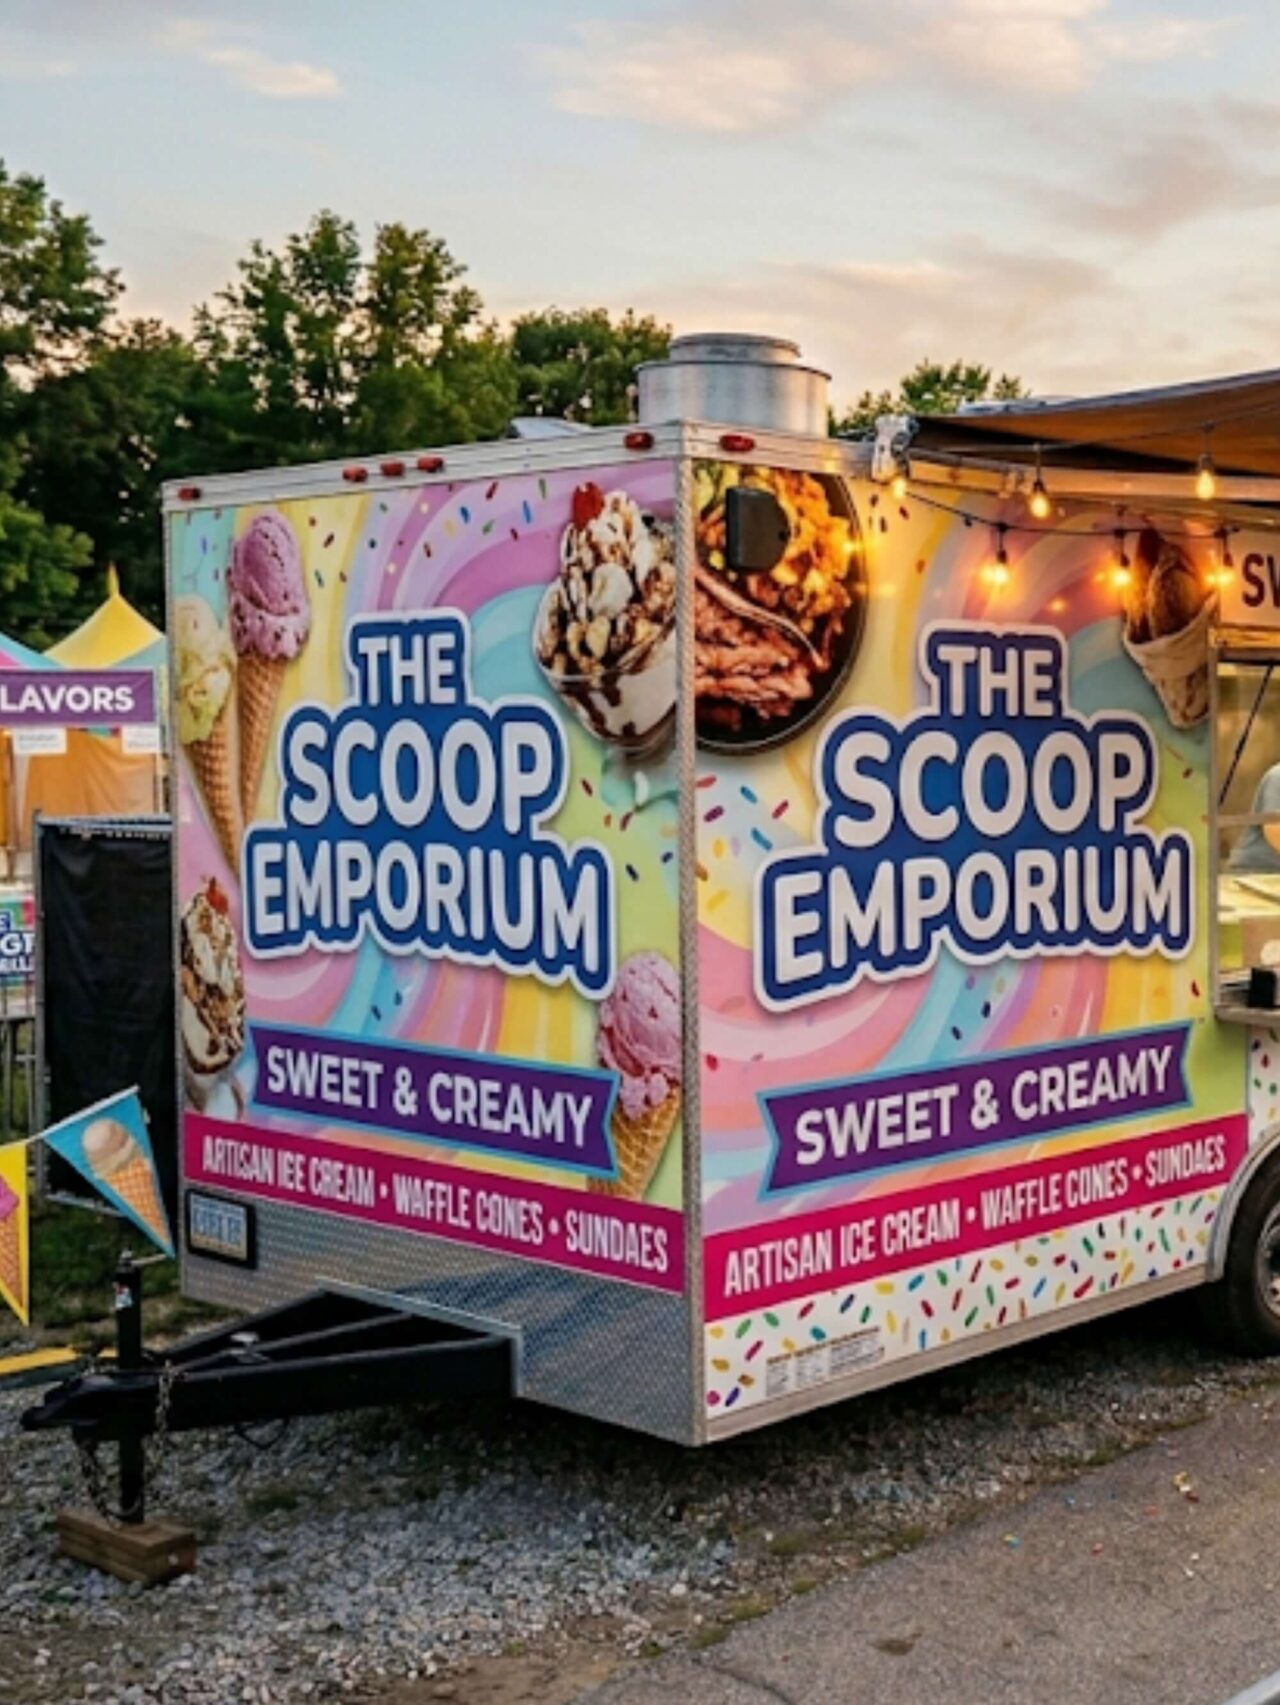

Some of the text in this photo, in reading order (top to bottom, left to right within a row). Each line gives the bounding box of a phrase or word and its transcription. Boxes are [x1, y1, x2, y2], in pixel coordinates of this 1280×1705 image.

[0, 684, 135, 713] LAVORS
[358, 632, 457, 705] THE
[937, 645, 1054, 717] THE
[289, 718, 553, 835] SCOOP
[834, 730, 1146, 848] SCOOP
[252, 839, 600, 974] EMPORIUM
[774, 847, 1183, 984] EMPORIUM
[266, 1045, 593, 1147] SWEET & CREAMY
[796, 1045, 1174, 1165] SWEET & CREAMY
[203, 1135, 275, 1186] ARTISAN
[309, 1156, 375, 1208] CREAM
[393, 1173, 471, 1229] WAFFLE
[475, 1191, 544, 1245] CONES
[566, 1209, 668, 1273] SUNDAES
[724, 1135, 1226, 1297] ARTISAN ICE CREAM WAFFLE CONES SUNDAES
